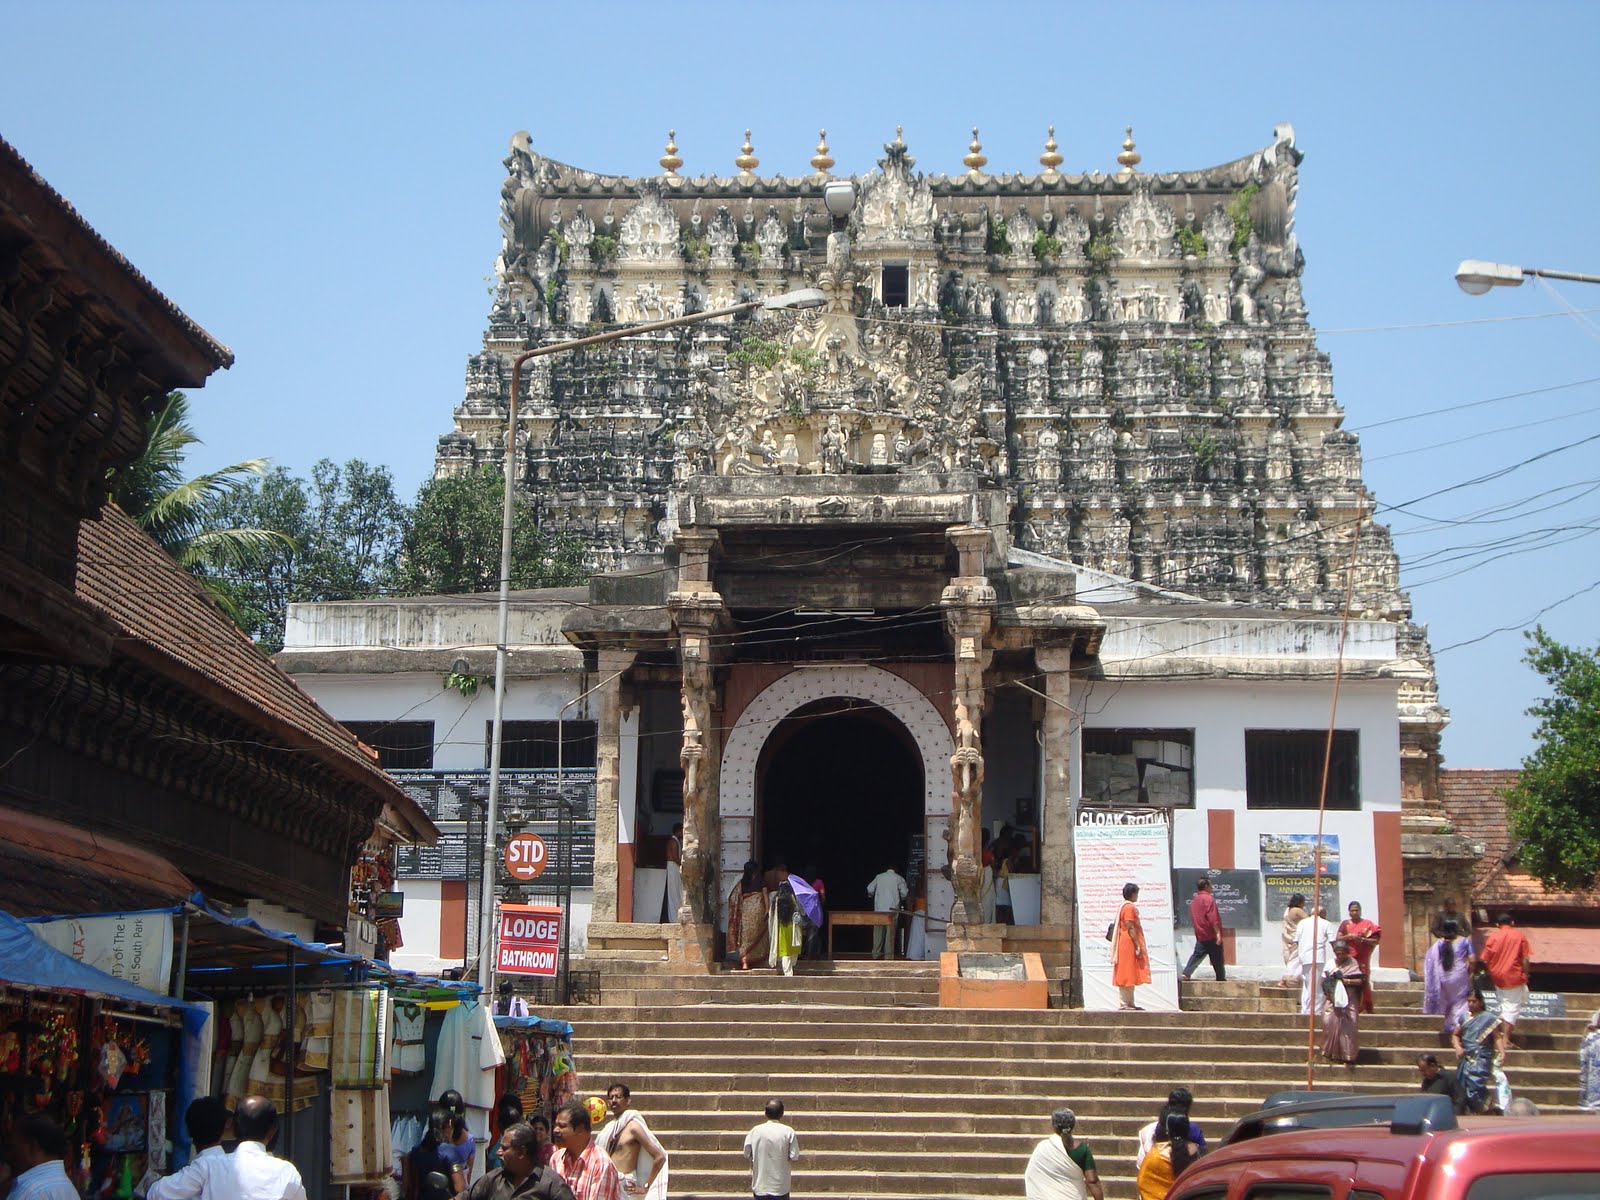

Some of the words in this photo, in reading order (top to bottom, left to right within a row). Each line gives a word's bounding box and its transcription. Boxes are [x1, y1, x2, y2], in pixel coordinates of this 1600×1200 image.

[1079, 811, 1124, 826] CLOAK
[1127, 812, 1165, 825] ROOM
[509, 840, 544, 864] STD
[113, 924, 125, 945] The
[133, 919, 143, 938] Park
[503, 918, 558, 940] LODGE
[114, 948, 124, 960] of
[131, 941, 142, 969] South
[501, 950, 554, 969] BATHROOM
